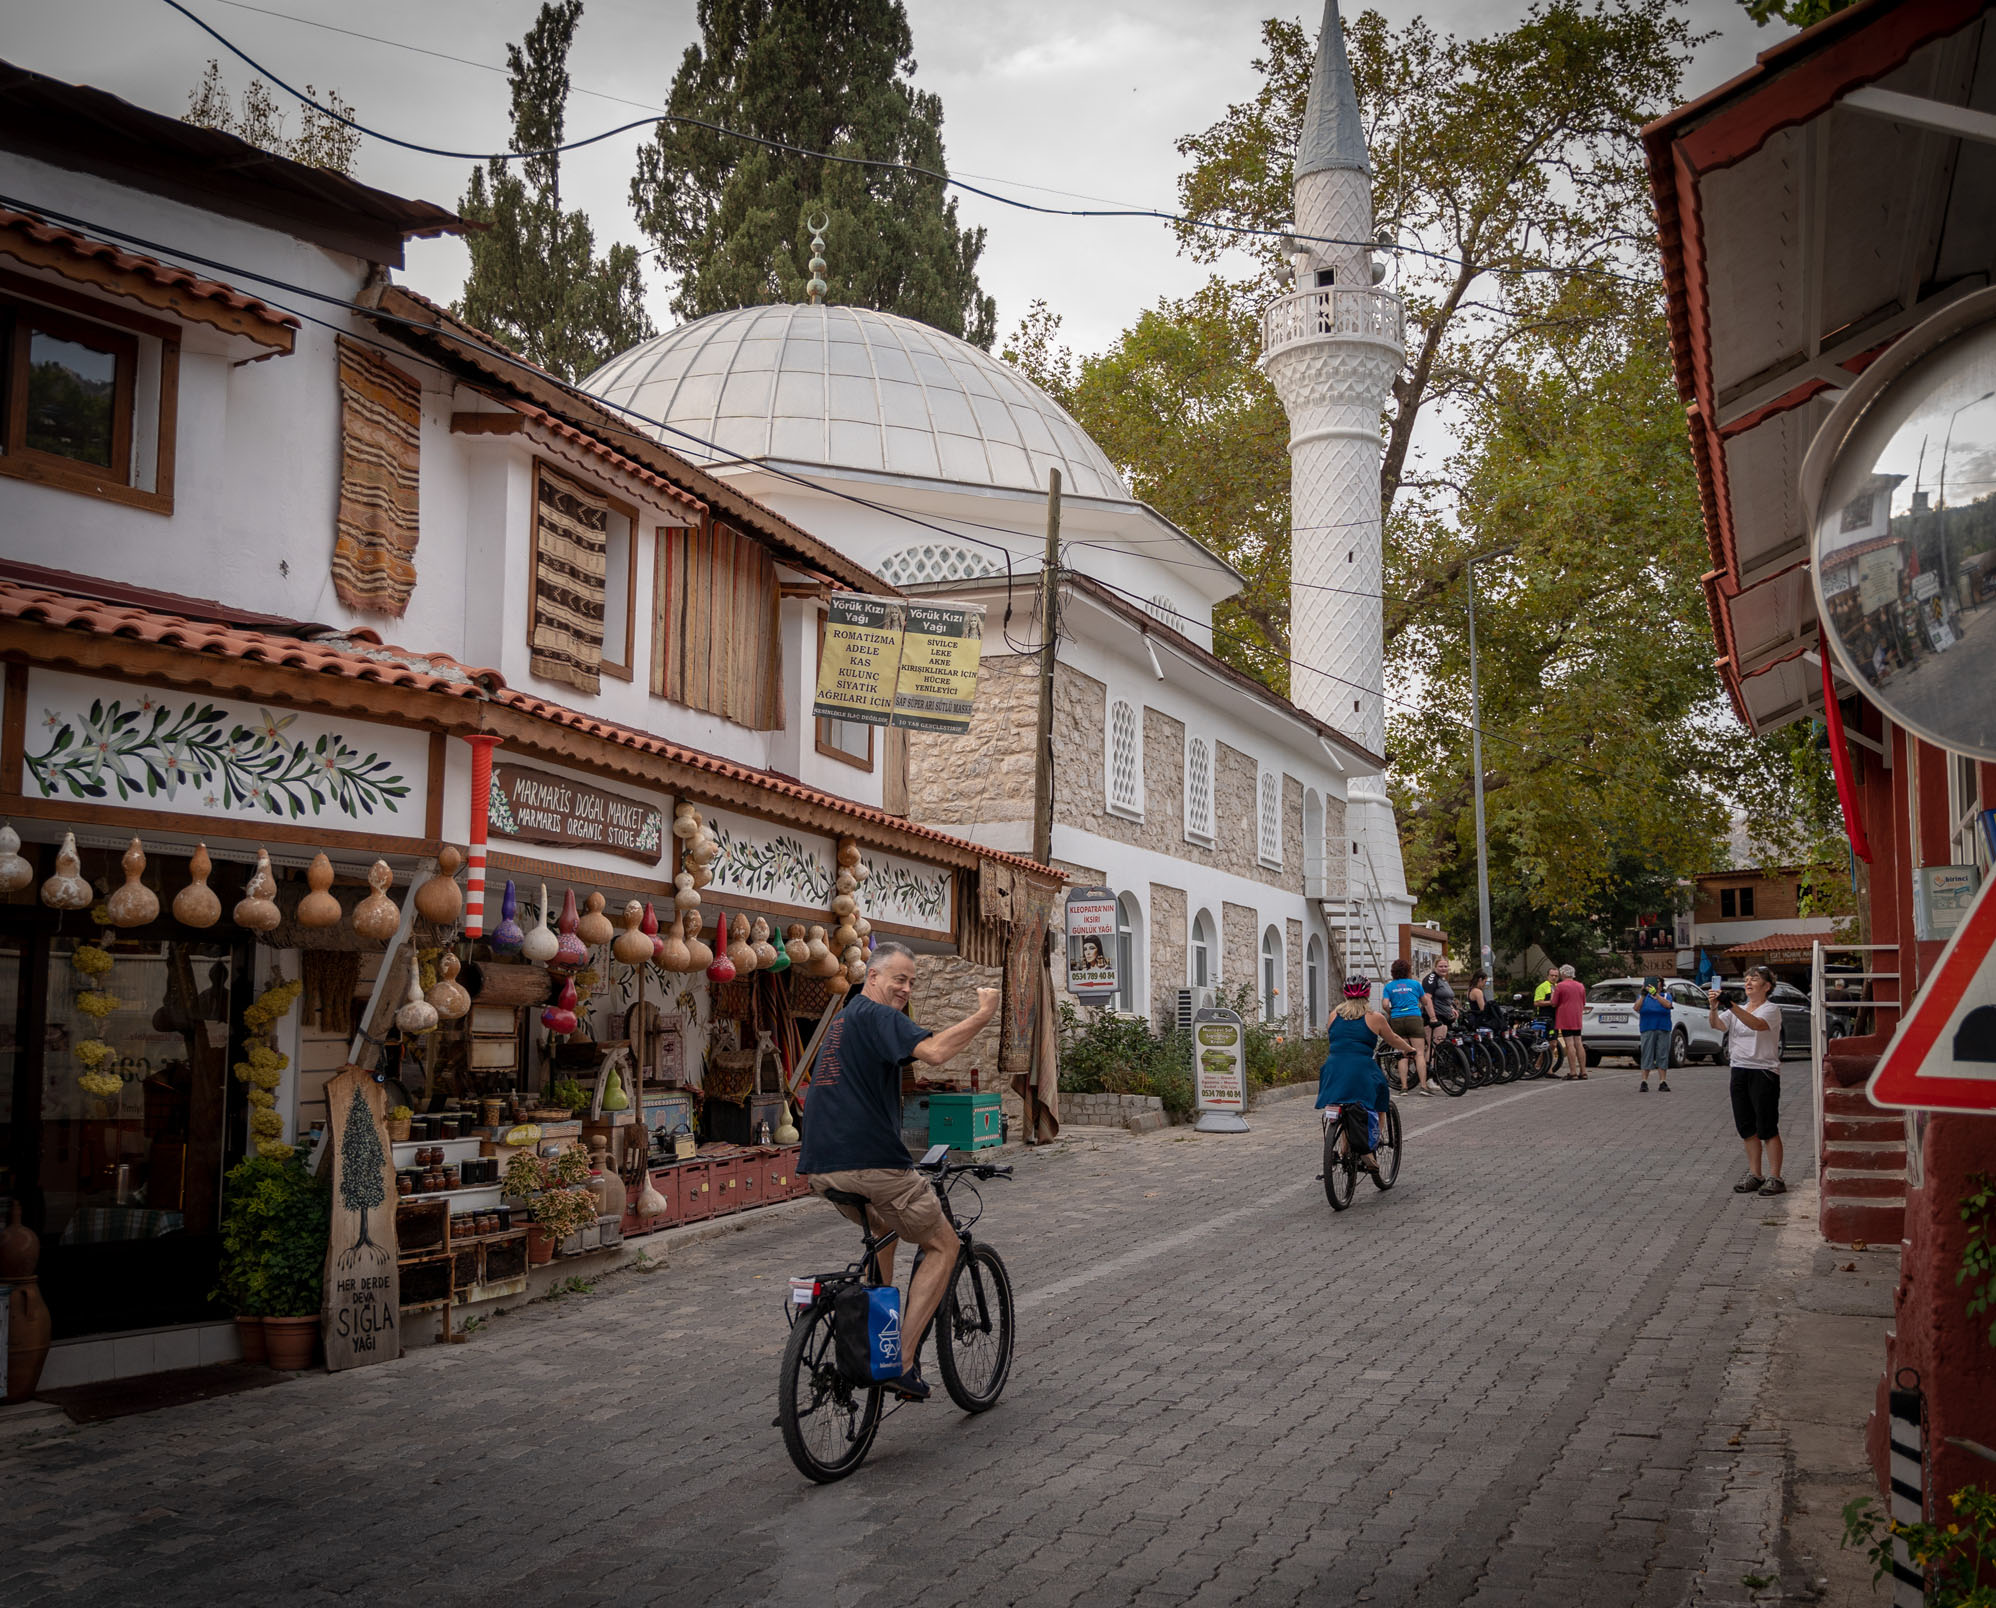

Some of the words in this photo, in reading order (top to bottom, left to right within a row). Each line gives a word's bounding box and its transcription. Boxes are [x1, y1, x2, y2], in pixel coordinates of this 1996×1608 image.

[832, 600, 862, 612] Yörük
[864, 603, 884, 614] Kızı
[845, 612, 868, 624] Yağı
[910, 609, 940, 620] Yörük
[942, 612, 963, 622] Kızı
[923, 622, 946, 633] Yağı
[833, 629, 895, 645] ROMATİZMA
[845, 644, 879, 655] ADELE
[927, 639, 958, 648] SİVİLCE
[931, 649, 952, 657] LEKE
[850, 657, 871, 666] KAS
[839, 668, 880, 682] KULUNÇ
[924, 675, 951, 685] HÜCRE
[837, 679, 878, 693] SİYATİK
[915, 684, 958, 695] YENİLEYİCİ
[817, 689, 866, 704] AĞRILARI
[870, 696, 891, 708] İÇİN
[895, 697, 907, 706] SAF
[513, 777, 571, 813] MARMARİS
[575, 793, 604, 821] DOĞAL
[607, 801, 643, 830] MARKET
[518, 808, 561, 833] MARMARIS
[568, 818, 602, 841] ORGANIC
[608, 827, 635, 848] STORE
[1070, 905, 1114, 913] KLEOPATRA'NIN
[1072, 926, 1097, 934] GÜNLÜK
[1098, 924, 1112, 933] YAĞI
[1099, 972, 1107, 980] 40
[337, 1278, 356, 1292] HER
[361, 1276, 390, 1290] DERDE
[353, 1291, 375, 1304] DEVA
[337, 1302, 394, 1337] SIĞLA
[352, 1334, 376, 1353] YAĞI
